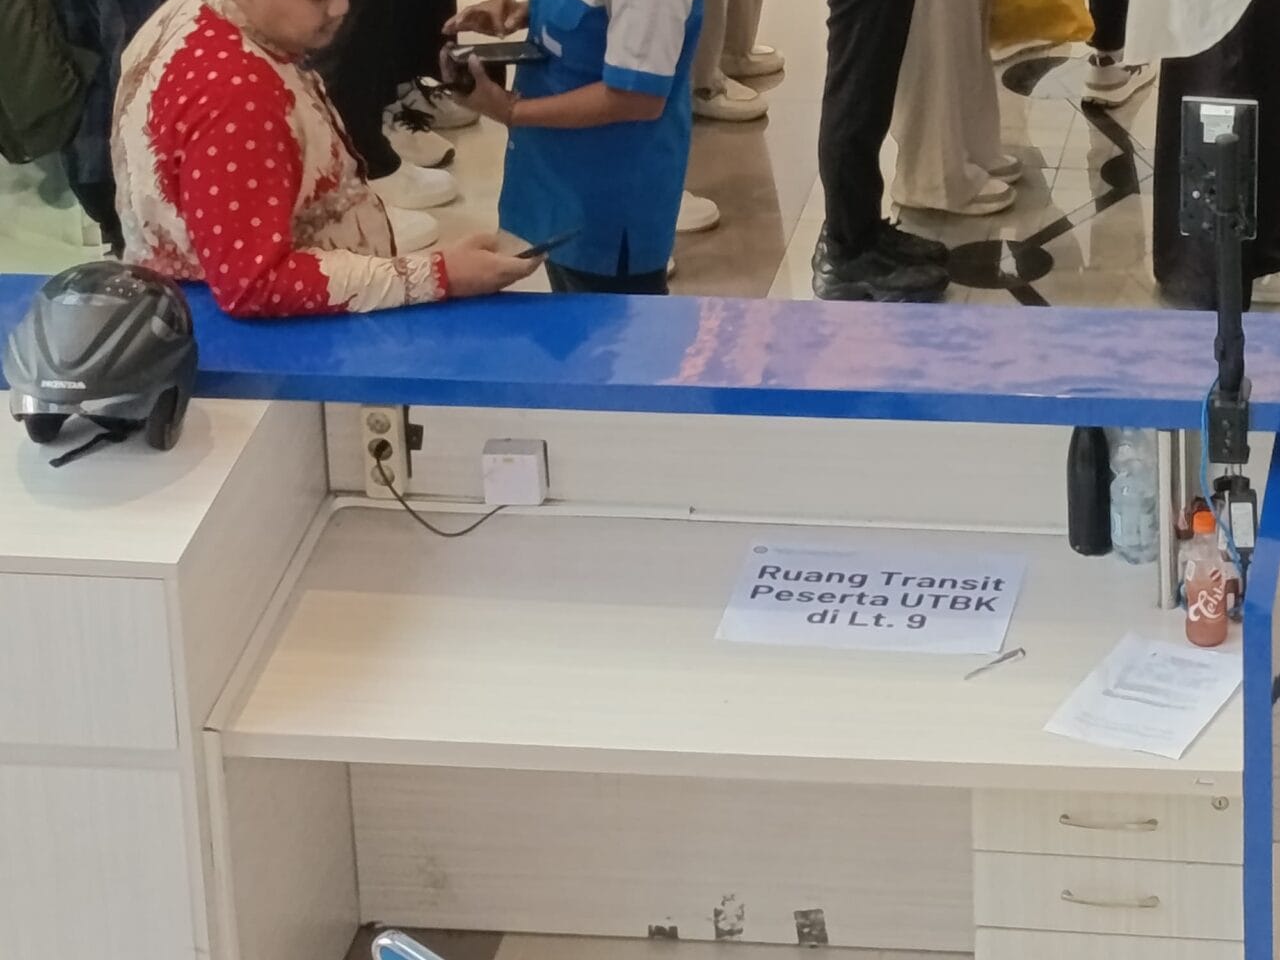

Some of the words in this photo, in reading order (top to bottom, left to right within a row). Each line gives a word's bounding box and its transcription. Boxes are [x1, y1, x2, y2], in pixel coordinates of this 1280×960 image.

[757, 564, 868, 589] Ruang
[881, 571, 1006, 592] Transit
[750, 584, 889, 607] Peserta
[900, 592, 999, 613] UTBK
[806, 608, 839, 625] di
[848, 610, 895, 628] Lt.
[906, 613, 928, 630] 9
